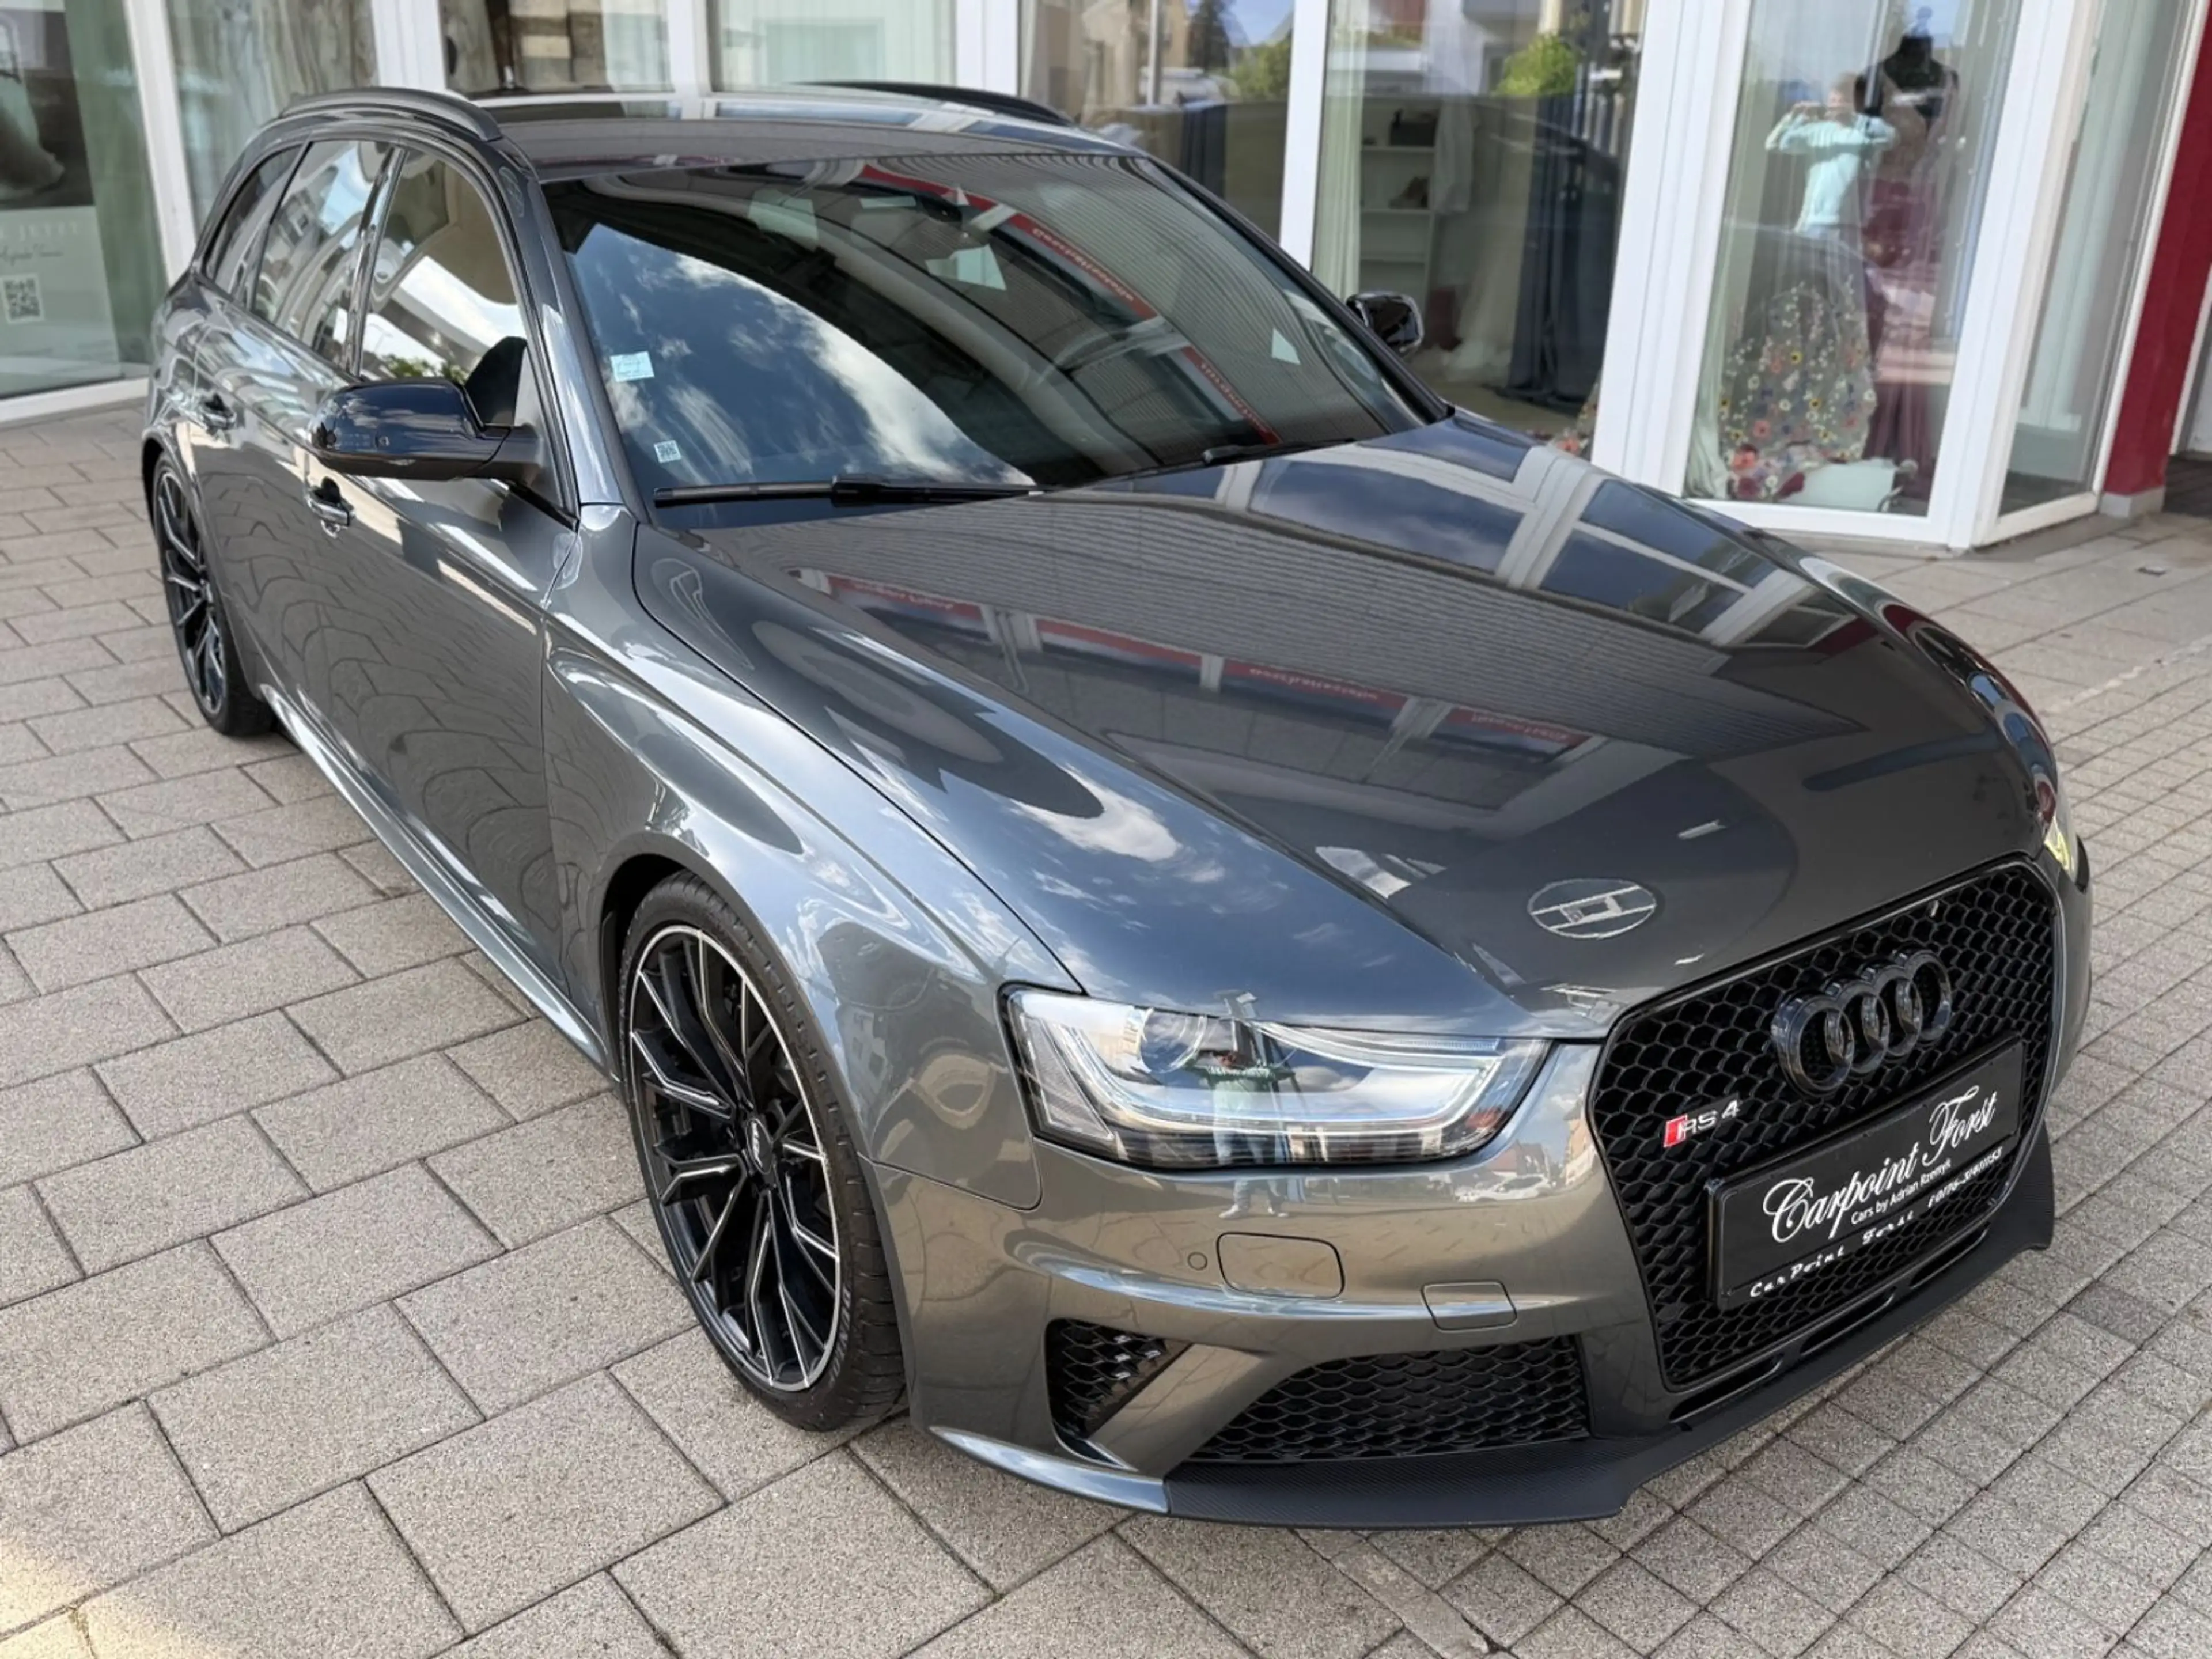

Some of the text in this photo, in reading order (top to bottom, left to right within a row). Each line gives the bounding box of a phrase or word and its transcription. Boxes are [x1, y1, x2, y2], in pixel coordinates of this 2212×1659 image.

[1763, 1142, 1919, 1243] Carpoint
[1922, 1085, 1998, 1166] Forst
[1851, 1207, 1874, 1225] Cars
[1876, 1199, 1888, 1214] by
